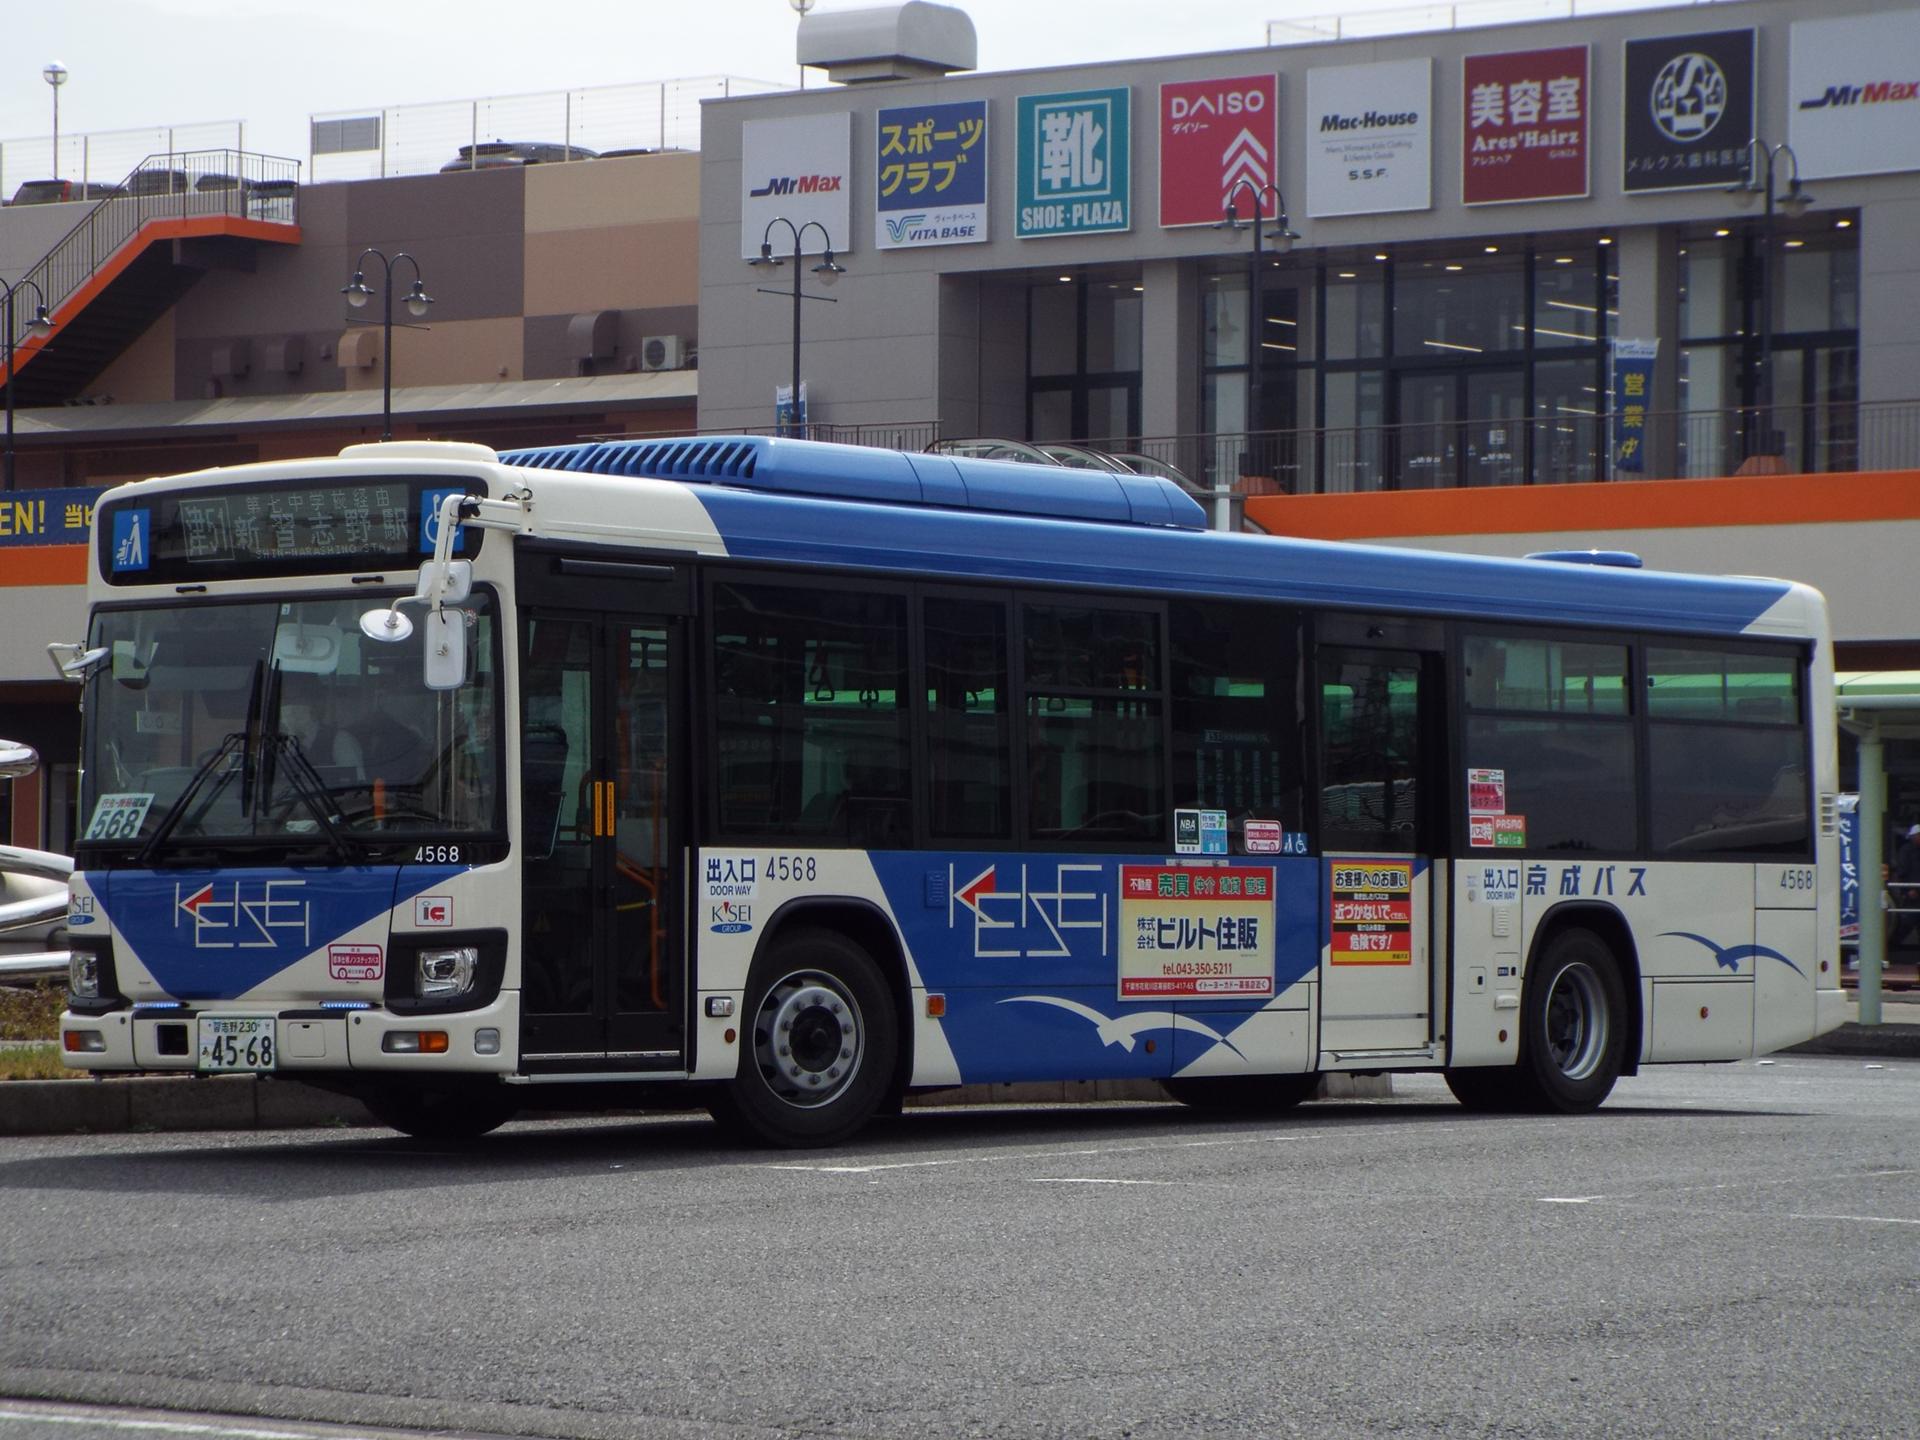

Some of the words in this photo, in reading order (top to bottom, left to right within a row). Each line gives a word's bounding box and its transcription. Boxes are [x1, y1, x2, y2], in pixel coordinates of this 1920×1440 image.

[1171, 90, 1265, 118] DAISO
[1472, 77, 1580, 128] 美容室
[1800, 81, 1920, 109] MrMax
[881, 118, 983, 156] スポーツ
[1172, 122, 1208, 135] ダイソー
[1041, 110, 1103, 190] 靴
[752, 174, 841, 197] MrMax
[881, 155, 968, 198] クラブ
[908, 228, 938, 242] VITA
[940, 225, 976, 240] BASE
[1621, 373, 1645, 459] 営業中
[235, 508, 408, 550] 新習志野駅
[91, 809, 140, 839] 568
[1180, 820, 1196, 829] NBA
[1496, 819, 1523, 829] PASMO
[1497, 834, 1521, 845] Suica
[415, 845, 460, 863] 4568
[706, 858, 755, 883] 出入口
[765, 856, 816, 881] 4568
[1335, 871, 1408, 887] お客様へのお願い
[1484, 868, 1519, 889] 出入口
[1780, 869, 1813, 890] 4568
[711, 886, 734, 896] DOOR
[735, 885, 752, 896] WAY
[1130, 878, 1152, 891] 不動産
[1158, 873, 1189, 897] 売買
[1194, 876, 1216, 895] 仲介
[1219, 877, 1241, 895] 賃貸
[1244, 877, 1267, 895] 管理
[1526, 865, 1647, 897] 京成バス
[1486, 891, 1502, 900] DOOR
[1504, 891, 1516, 899] WAY
[175, 881, 310, 947] KEISEI
[949, 863, 1107, 958] KEISEI
[1335, 904, 1390, 920] 近づかないで
[1136, 917, 1156, 933] 株式
[1156, 916, 1258, 951] ビルト住販
[1136, 936, 1156, 950] 会社
[1163, 962, 1233, 975] tel.043-350-5211
[213, 1021, 238, 1033] 習志野
[239, 1021, 258, 1033] 230
[212, 1035, 272, 1066] 45-68
